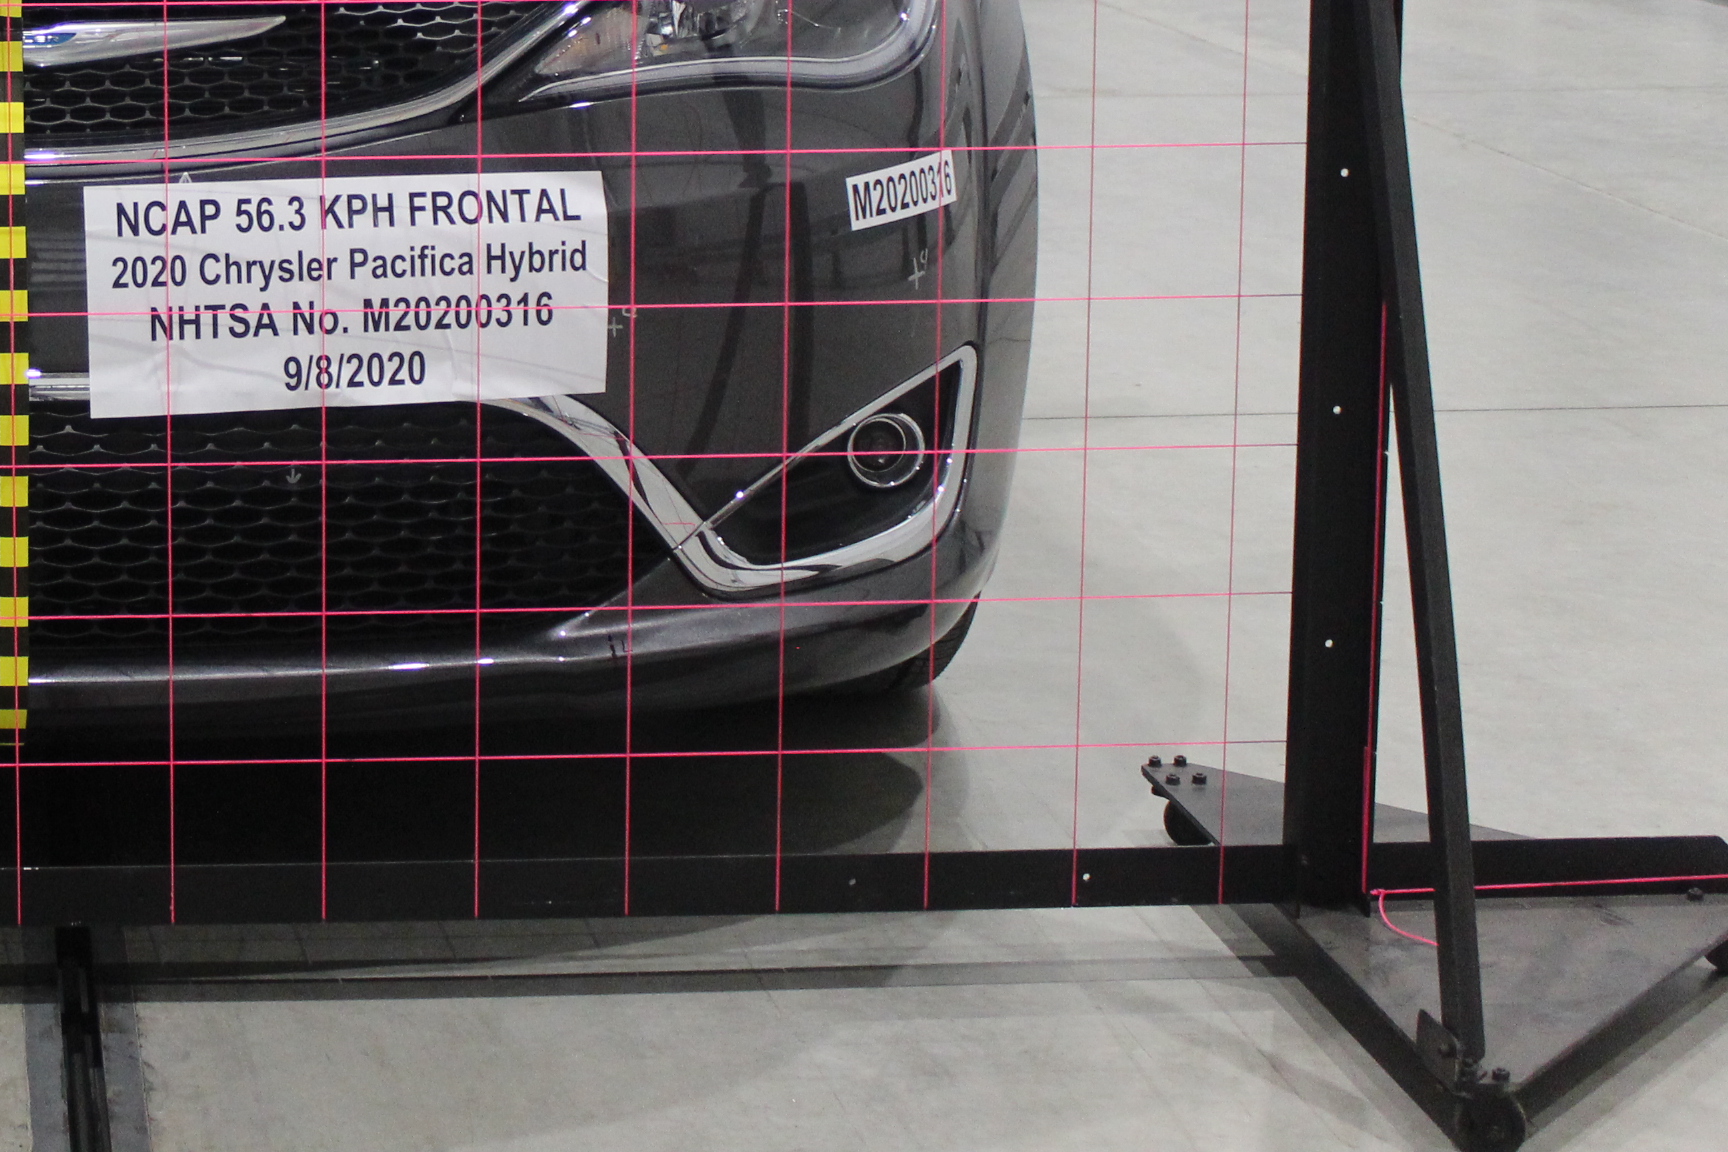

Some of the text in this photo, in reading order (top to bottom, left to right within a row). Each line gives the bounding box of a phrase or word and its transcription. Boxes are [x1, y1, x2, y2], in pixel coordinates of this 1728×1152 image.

[116, 188, 581, 237] NCAP 56.3 KPH FRONTAL
[852, 160, 952, 221] M20200316
[111, 240, 587, 291] 2020 Chrysler Pacifica Hybrid
[150, 291, 554, 341] NHTSA No. M20200316
[283, 350, 426, 392] 9/8/2020
